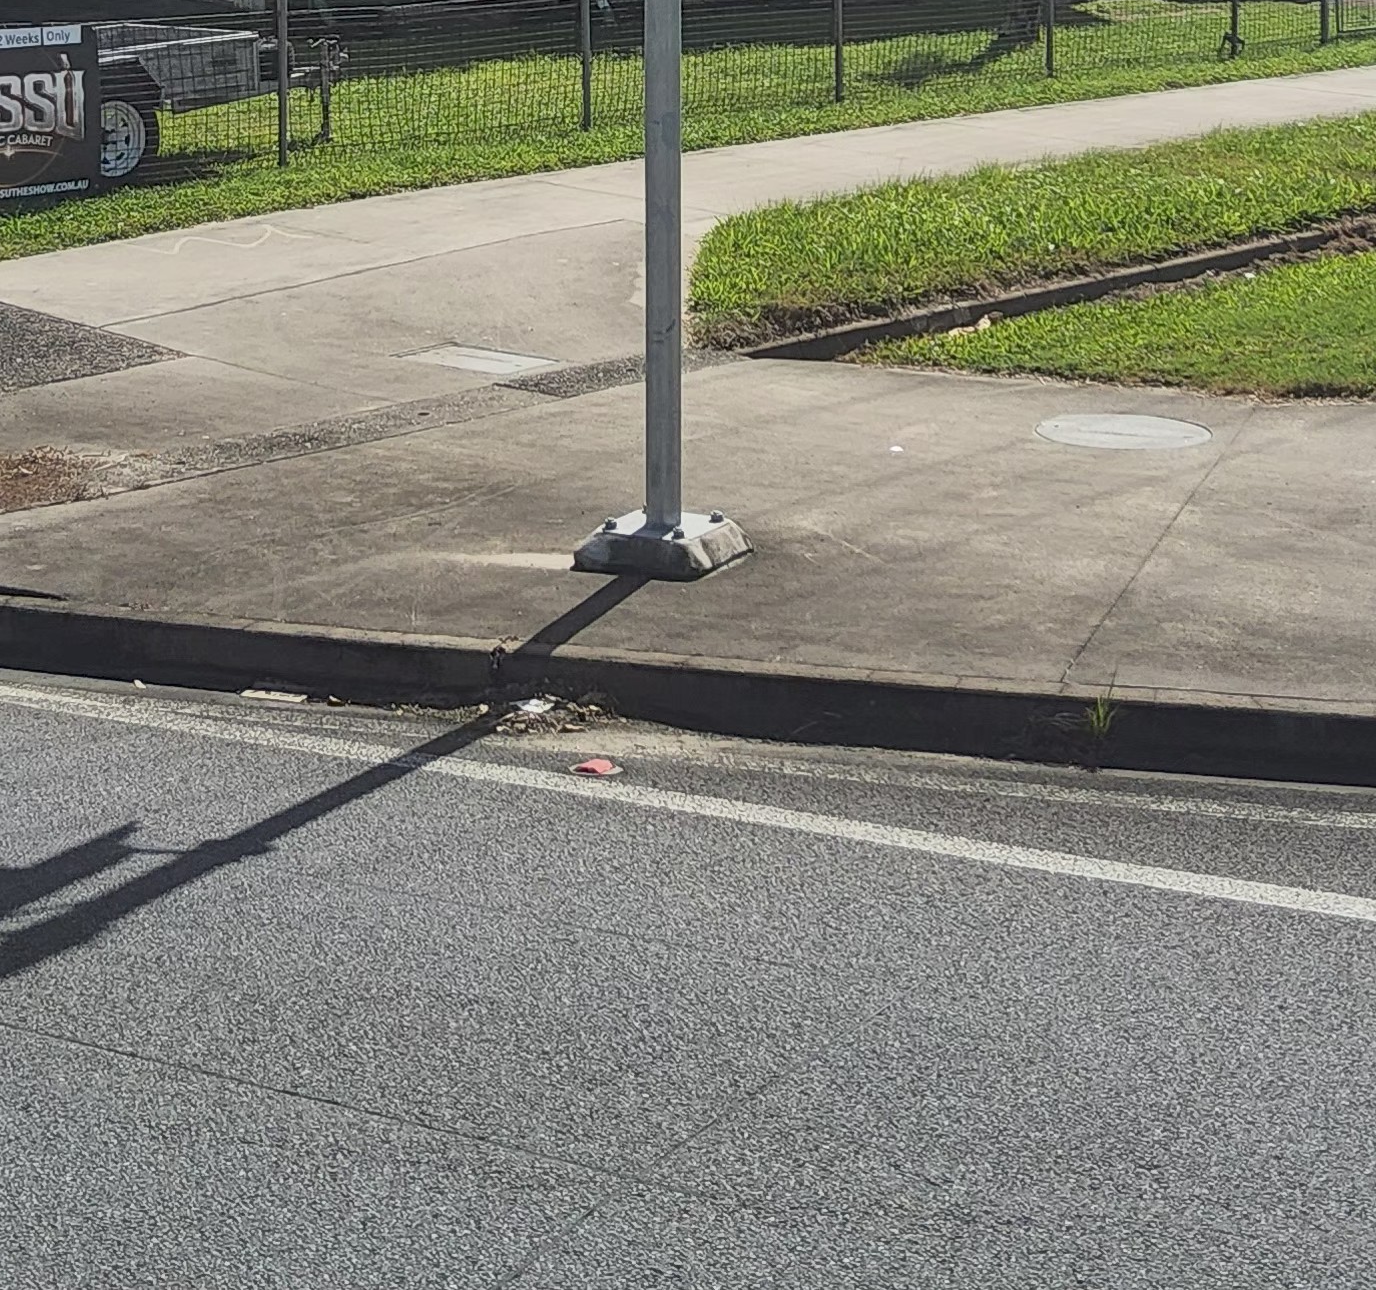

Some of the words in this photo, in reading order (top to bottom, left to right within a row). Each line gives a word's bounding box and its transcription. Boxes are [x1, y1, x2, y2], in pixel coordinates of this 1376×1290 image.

[5, 33, 39, 46] Weeks
[46, 30, 71, 43] Only
[7, 134, 53, 147] CABARET
